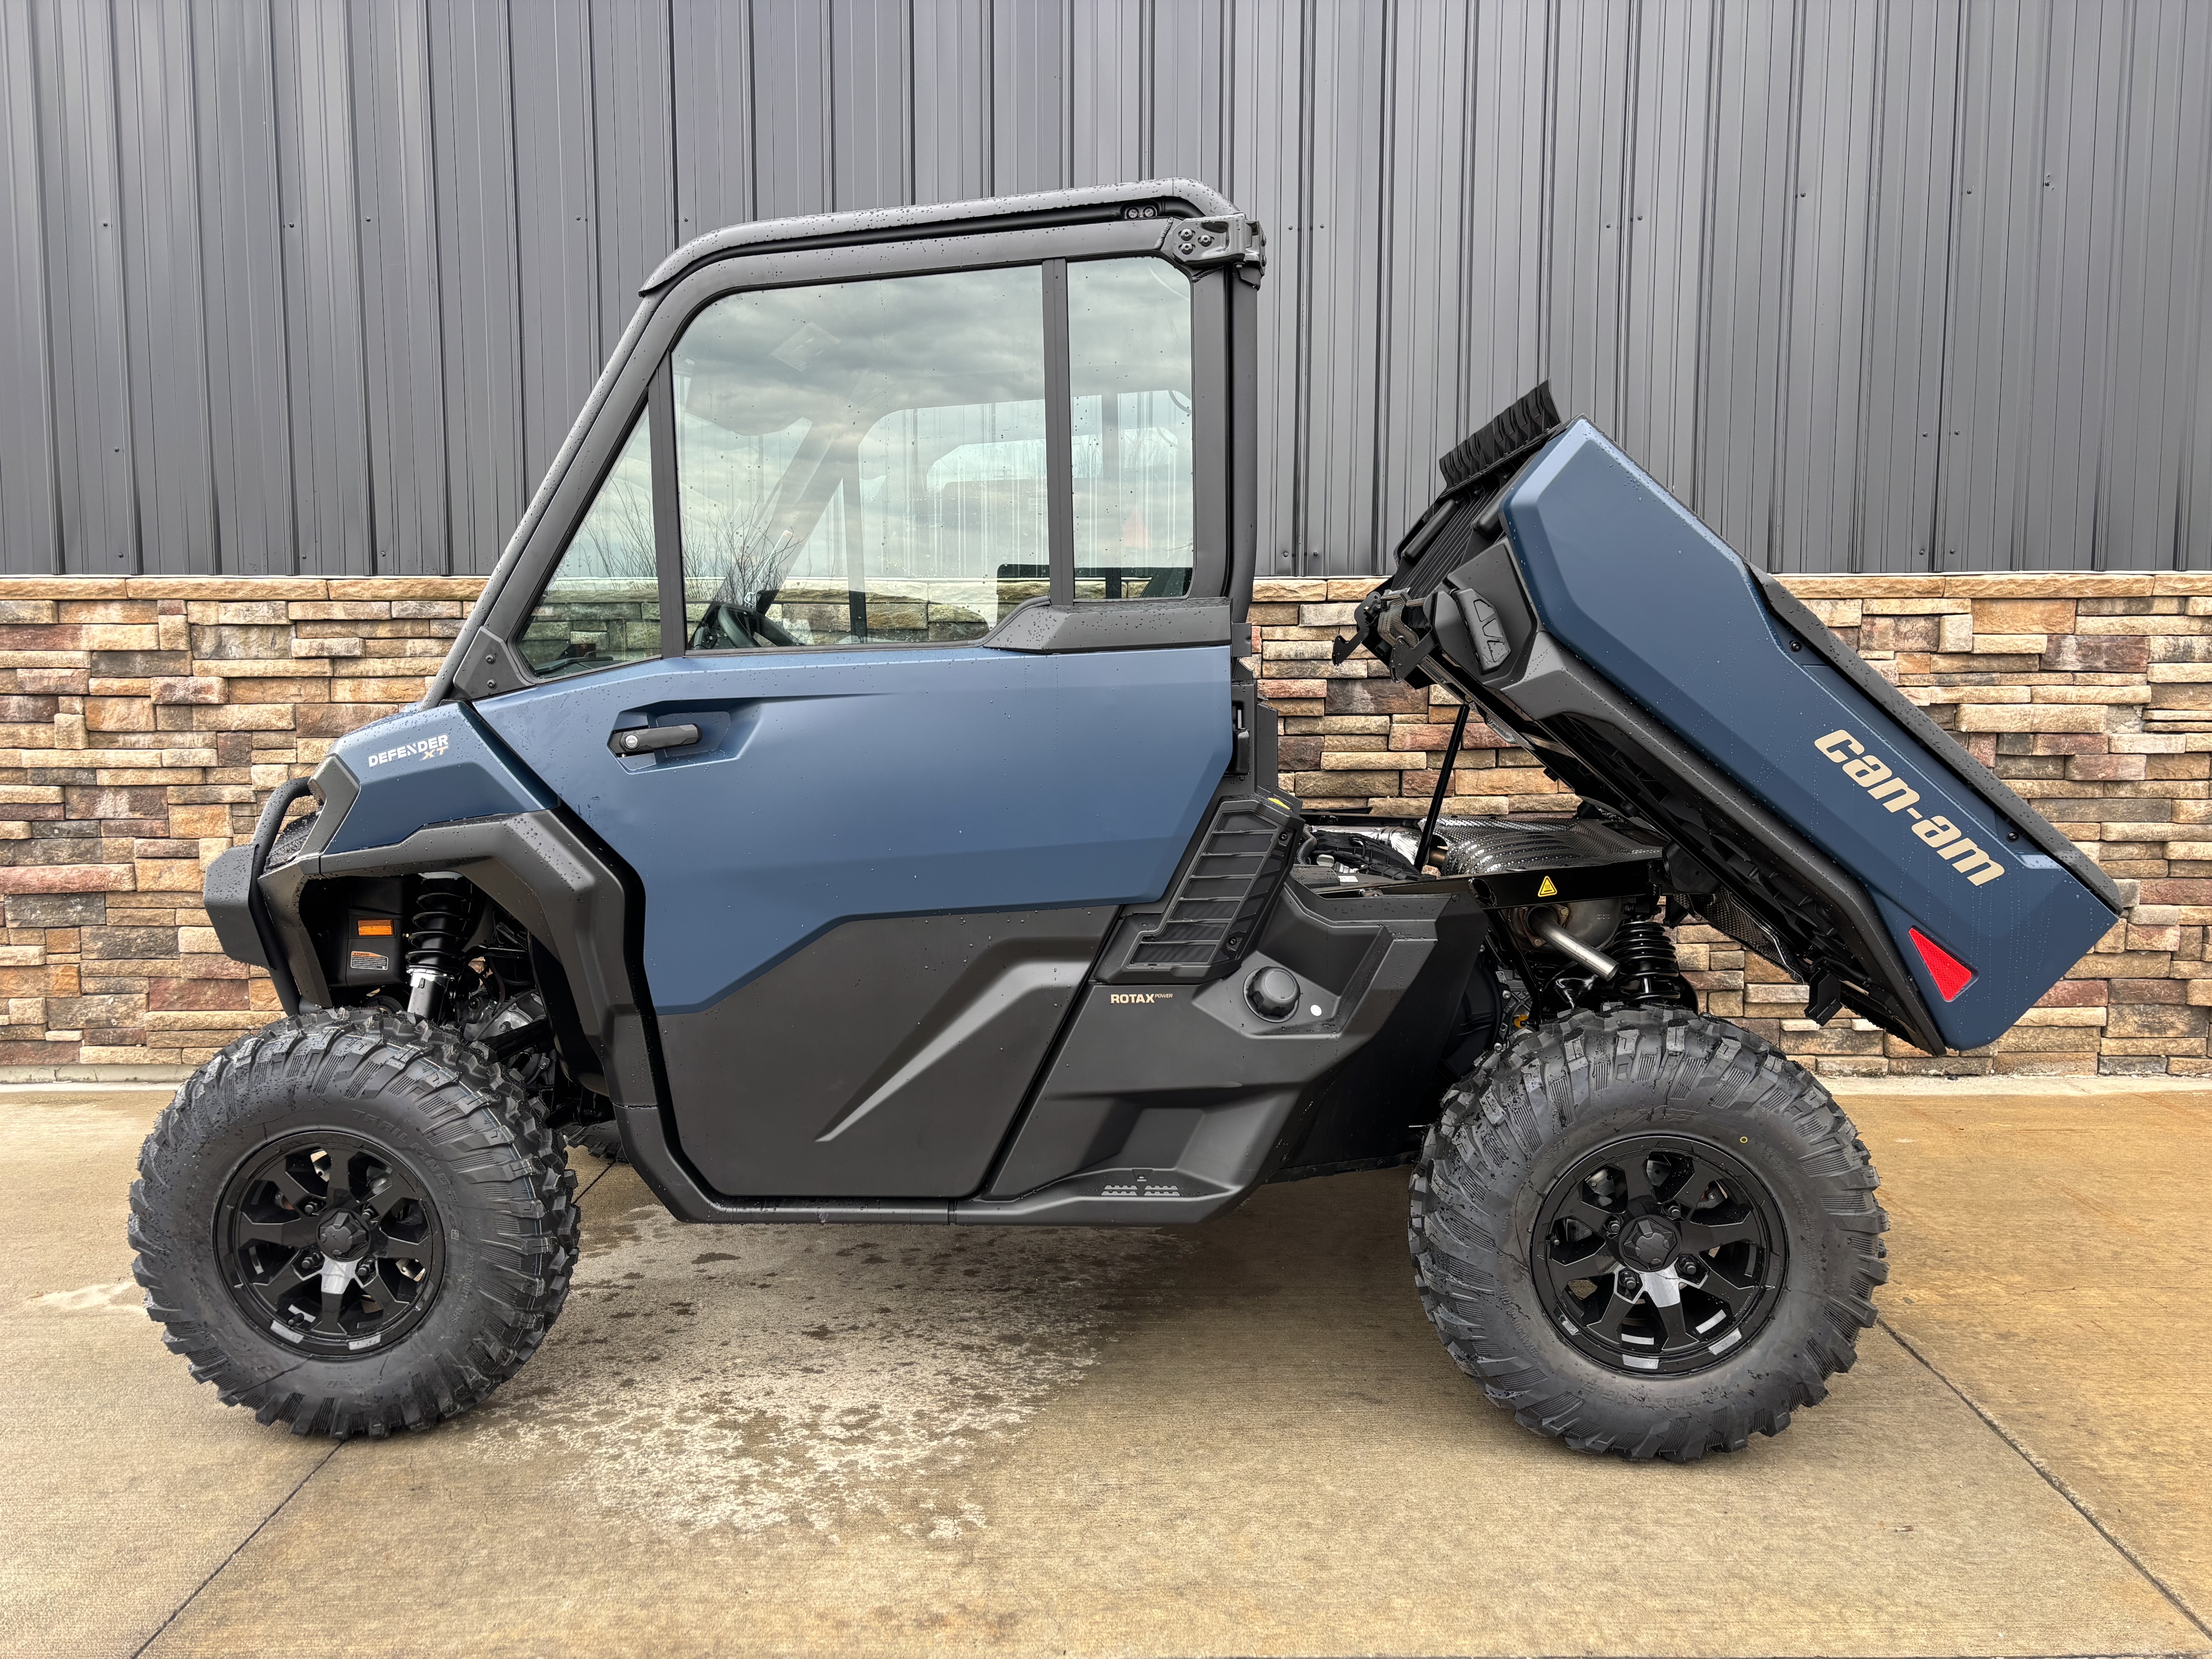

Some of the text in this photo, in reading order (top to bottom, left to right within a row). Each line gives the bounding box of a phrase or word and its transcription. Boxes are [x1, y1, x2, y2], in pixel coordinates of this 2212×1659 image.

[368, 734, 449, 768] DEFENDER
[422, 745, 449, 761] XT
[1814, 729, 2005, 886] can-am
[1110, 993, 1155, 1004] ROTAX
[352, 1109, 407, 1142] TRAIL
[409, 1142, 451, 1186] KING
